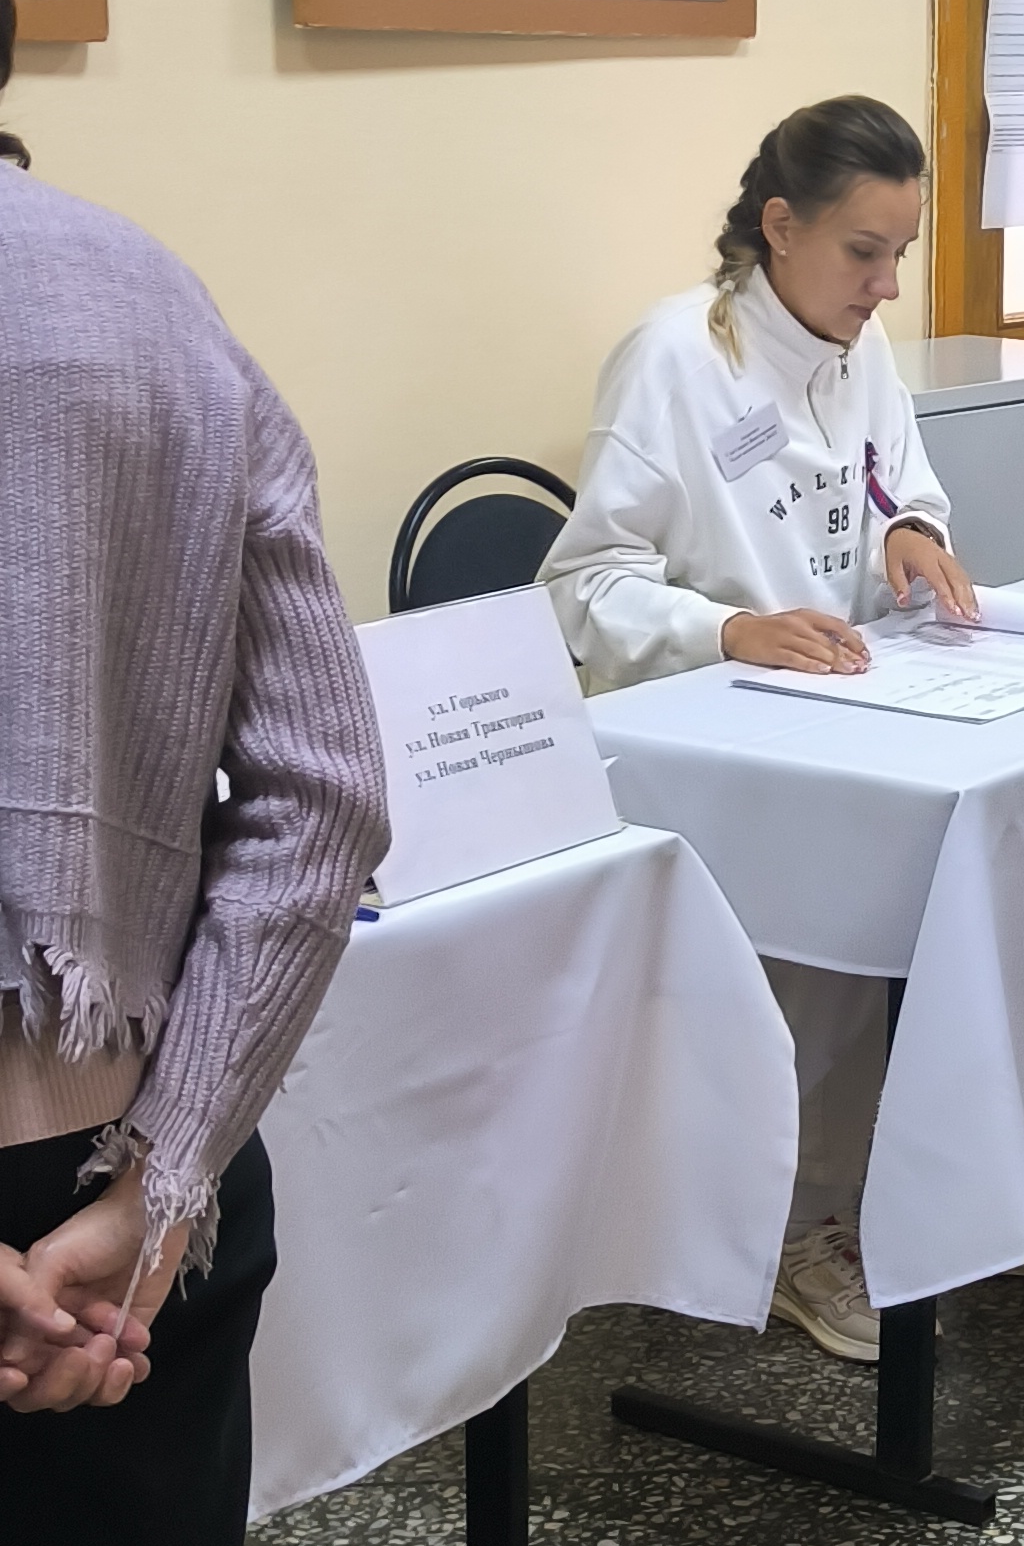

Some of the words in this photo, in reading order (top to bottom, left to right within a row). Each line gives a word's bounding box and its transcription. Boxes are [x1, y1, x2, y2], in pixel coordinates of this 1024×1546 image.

[827, 504, 850, 535] 98
[809, 547, 859, 576] CLU
[449, 687, 510, 712] Горького
[427, 728, 471, 748] Новая
[471, 709, 545, 738] Тракторная
[436, 757, 479, 777] Новая
